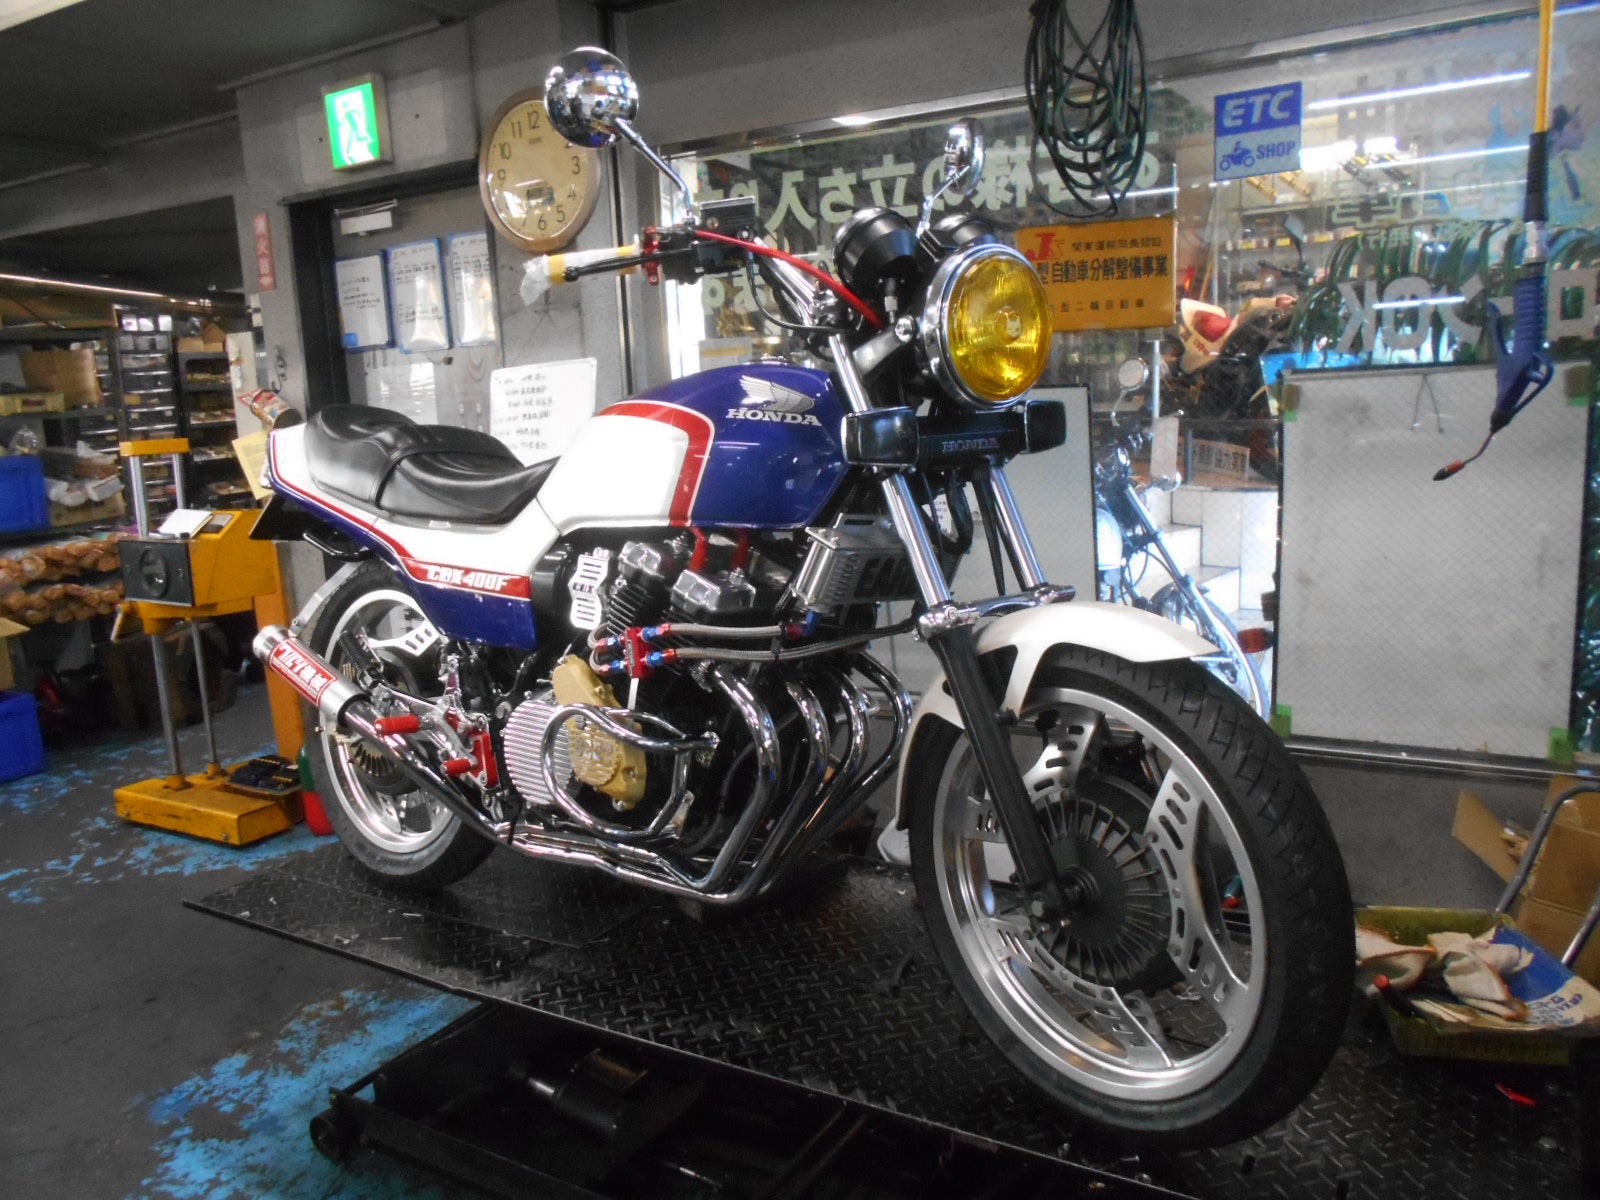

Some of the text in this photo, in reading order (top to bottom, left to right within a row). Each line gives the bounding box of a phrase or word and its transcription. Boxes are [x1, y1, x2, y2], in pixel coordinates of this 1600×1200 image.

[1223, 90, 1294, 128] ETC
[528, 110, 540, 129] 12
[511, 121, 523, 139] 11
[499, 142, 512, 160] 10
[1257, 141, 1296, 160] SHOP
[571, 155, 581, 175] 3
[497, 169, 507, 187] 9
[538, 214, 547, 231] 6
[556, 205, 566, 223] 5
[726, 408, 822, 427] HONDA
[943, 438, 1000, 453] HONDA
